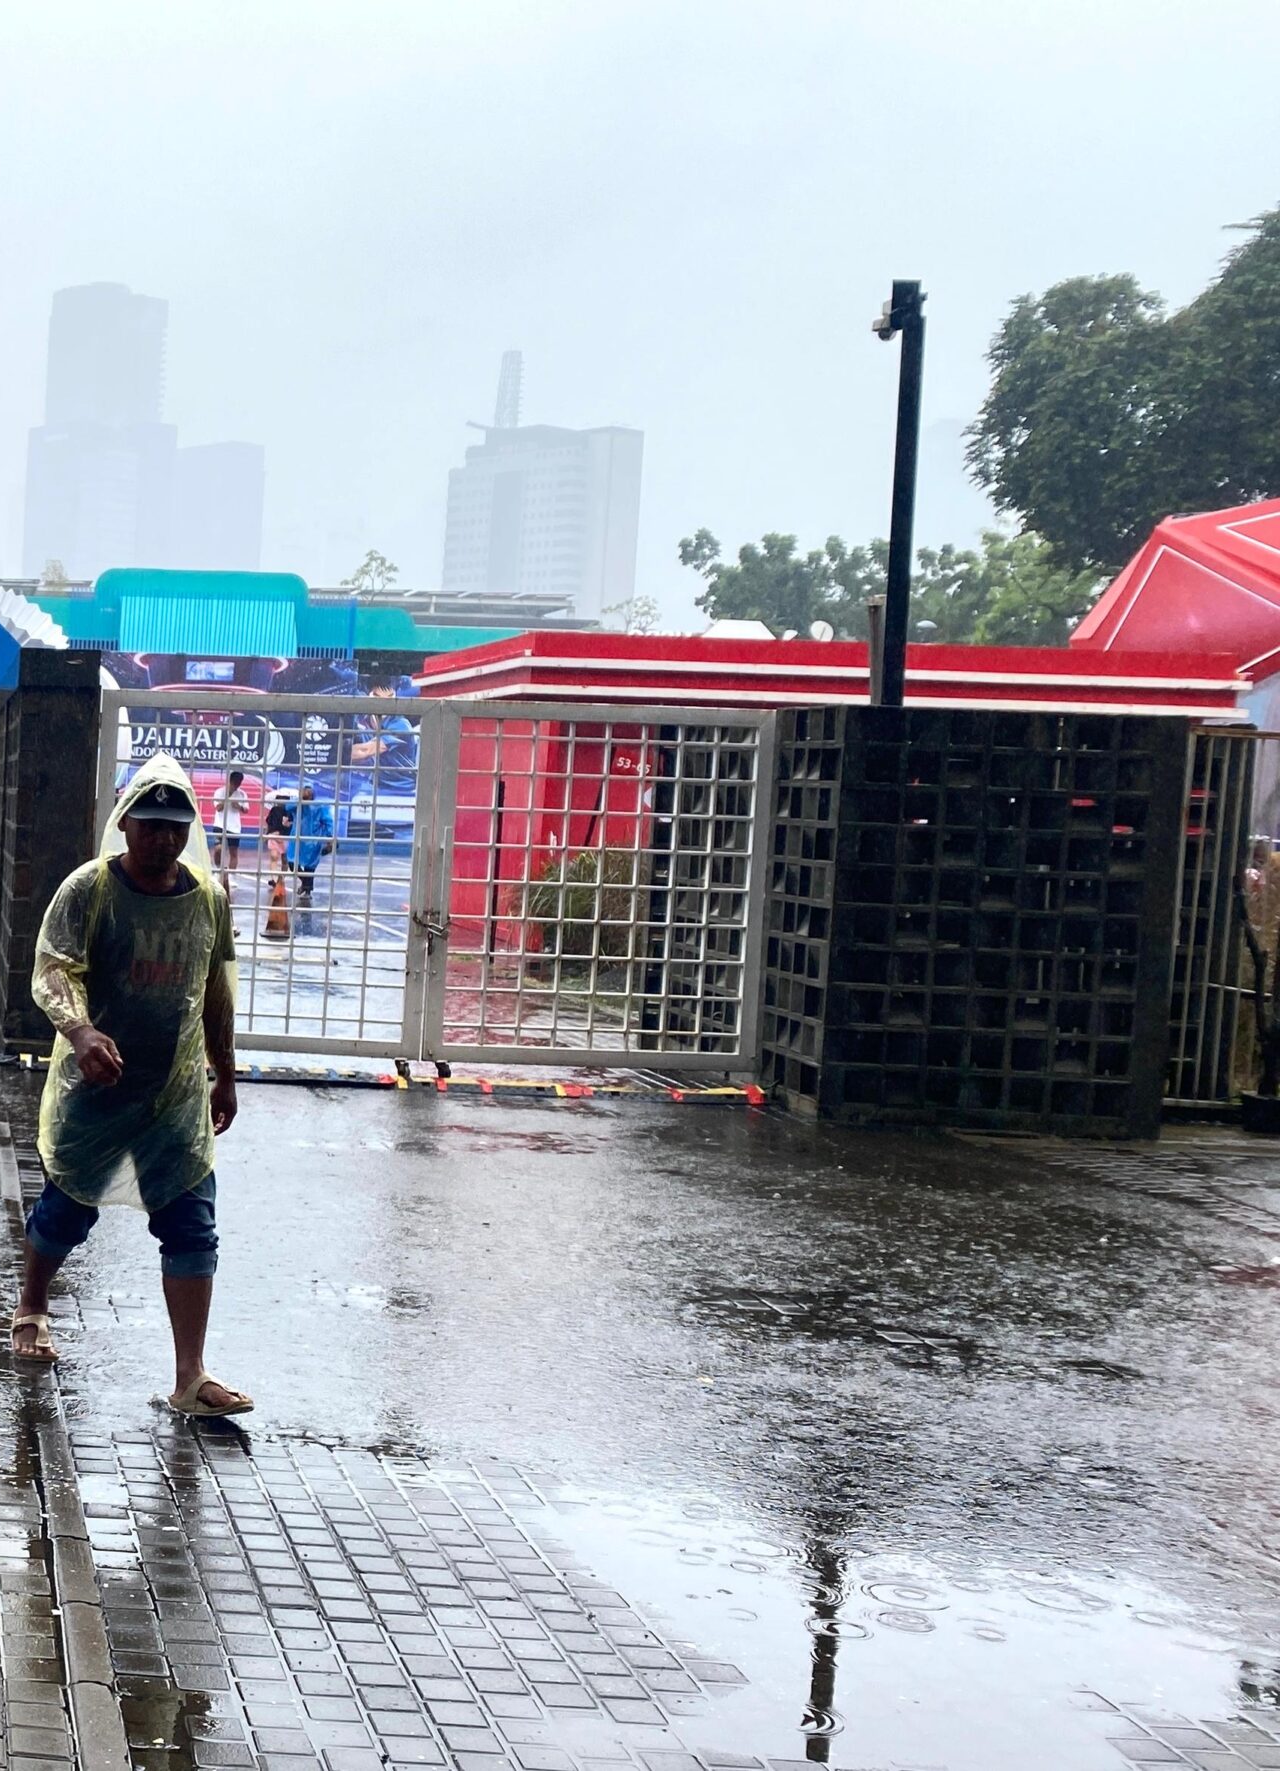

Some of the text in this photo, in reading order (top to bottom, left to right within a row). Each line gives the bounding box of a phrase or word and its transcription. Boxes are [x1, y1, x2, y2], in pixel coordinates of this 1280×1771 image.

[131, 726, 259, 749] DAIHATSU
[130, 746, 182, 759] NDOSIA
[233, 750, 259, 761] 2026
